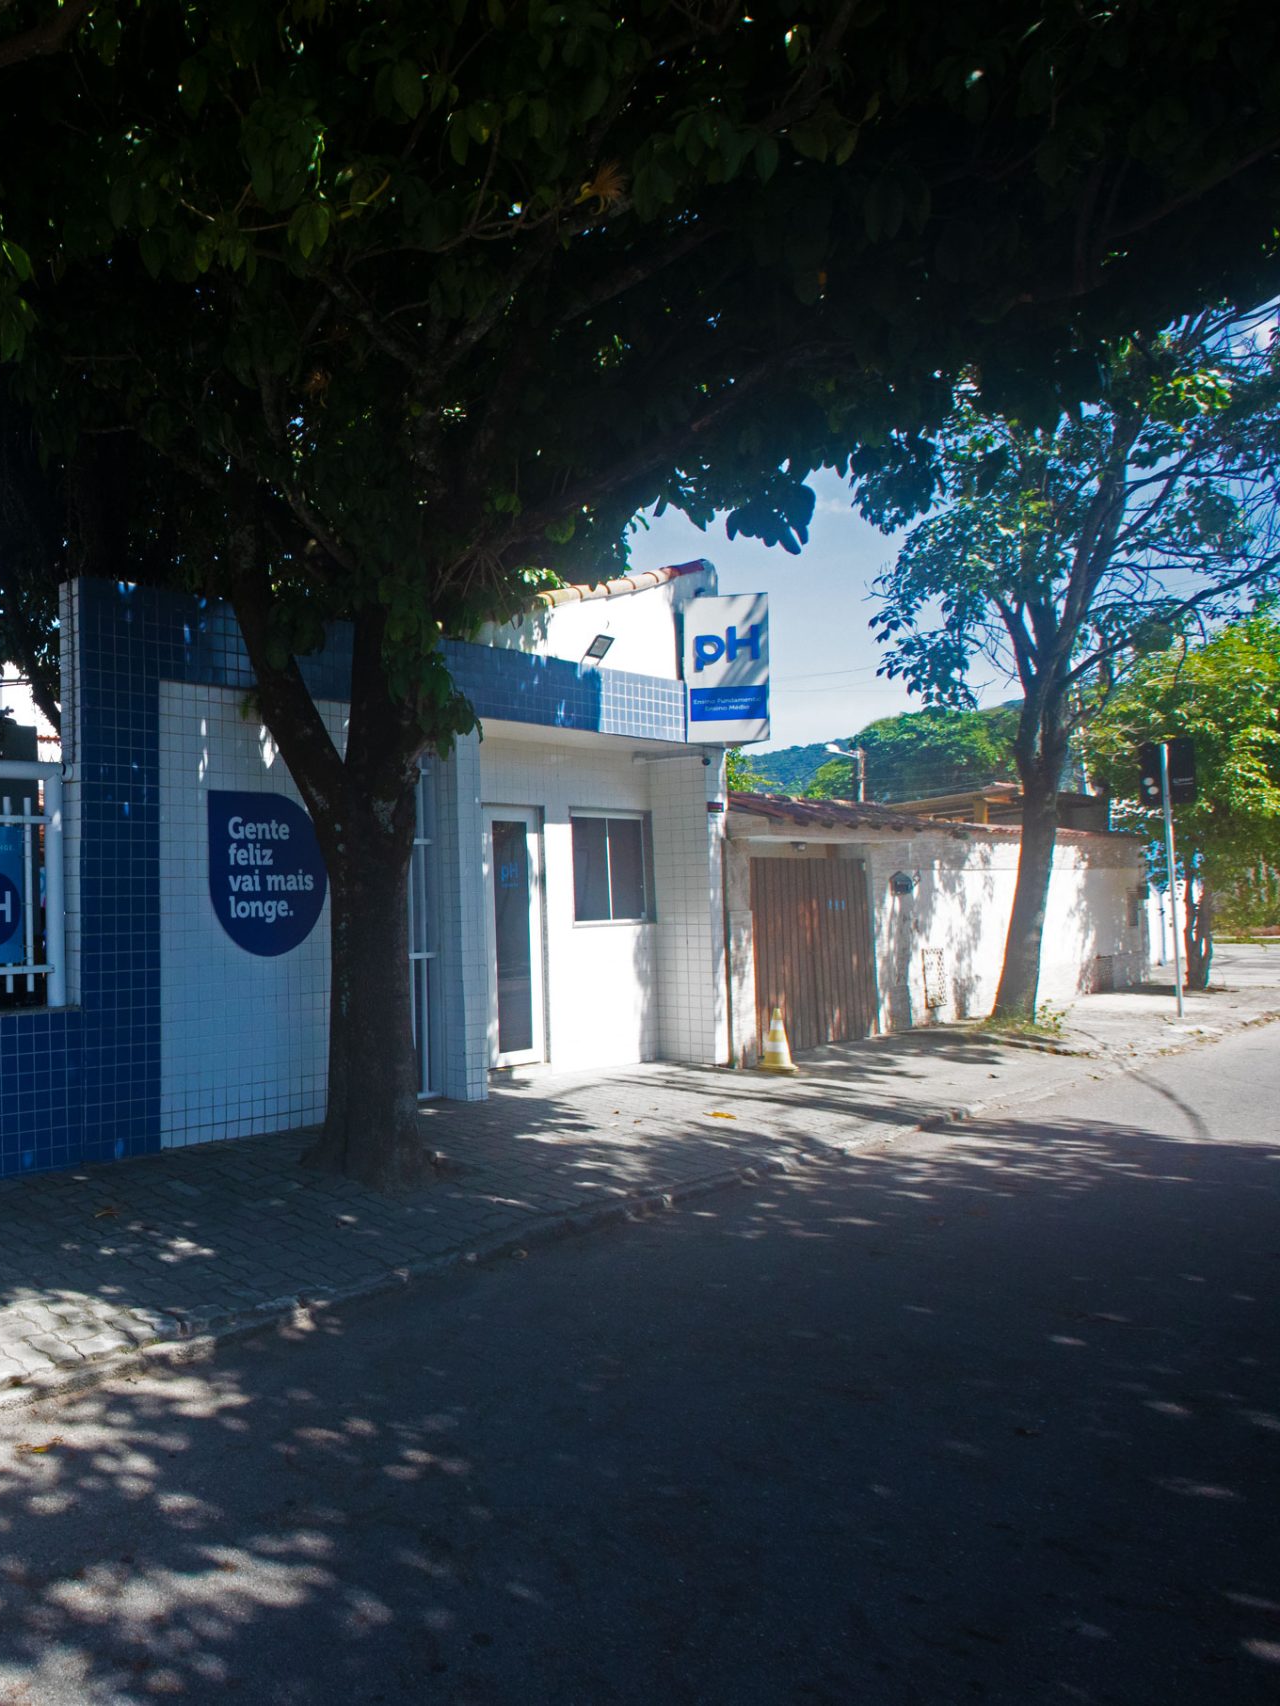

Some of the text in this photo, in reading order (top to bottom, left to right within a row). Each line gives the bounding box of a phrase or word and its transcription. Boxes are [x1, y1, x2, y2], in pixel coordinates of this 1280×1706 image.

[693, 624, 761, 673] pH
[228, 816, 290, 840] Gente
[228, 843, 273, 866] feliz
[228, 868, 314, 892] vai mais
[229, 896, 294, 923] longe.
